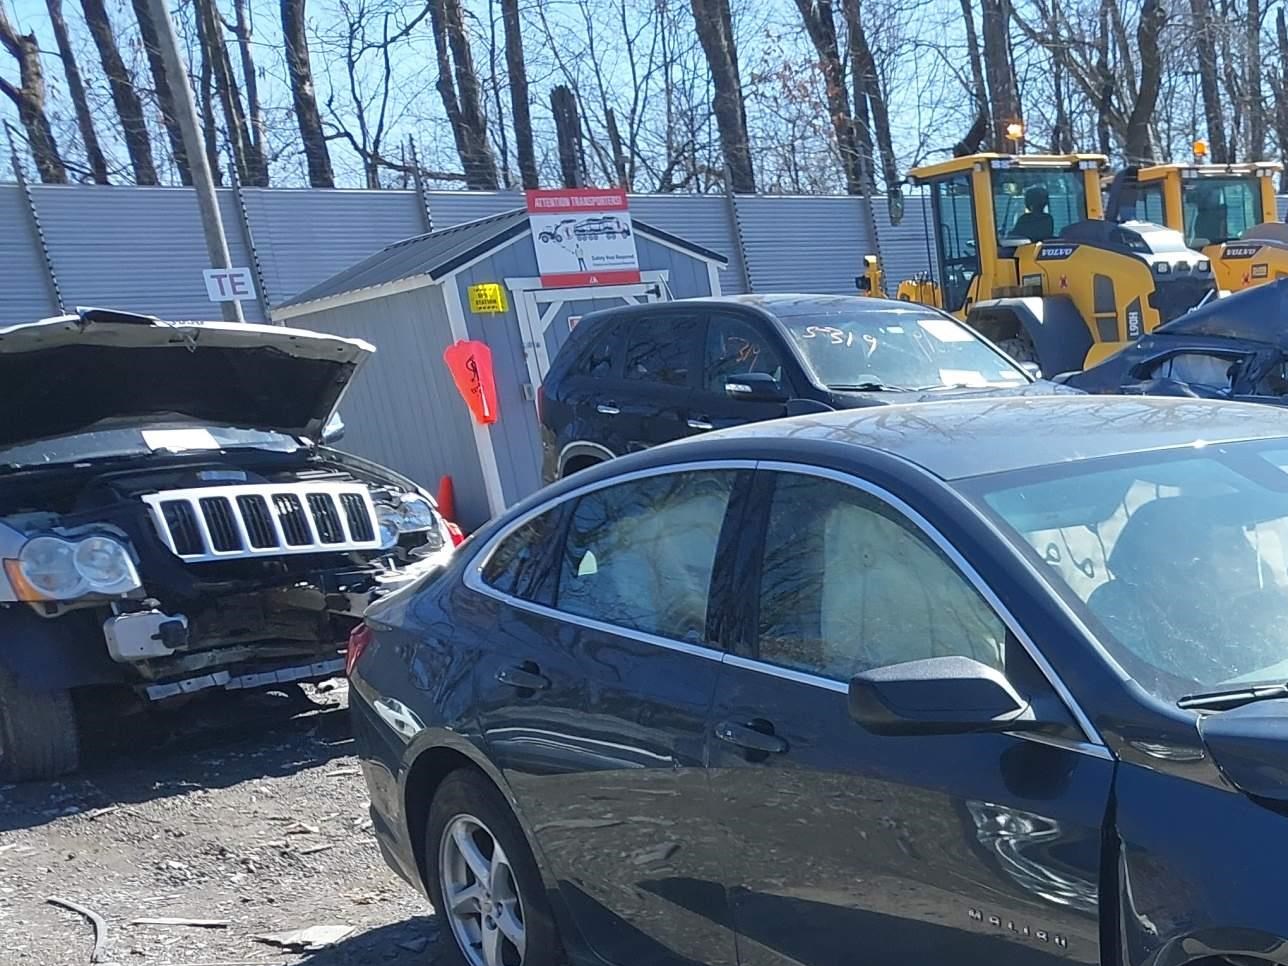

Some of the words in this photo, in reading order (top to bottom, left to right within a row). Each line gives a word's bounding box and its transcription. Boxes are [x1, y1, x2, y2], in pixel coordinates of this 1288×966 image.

[1041, 248, 1073, 257] VOLVO
[1226, 248, 1257, 256] VOLVO
[210, 273, 249, 296] TE
